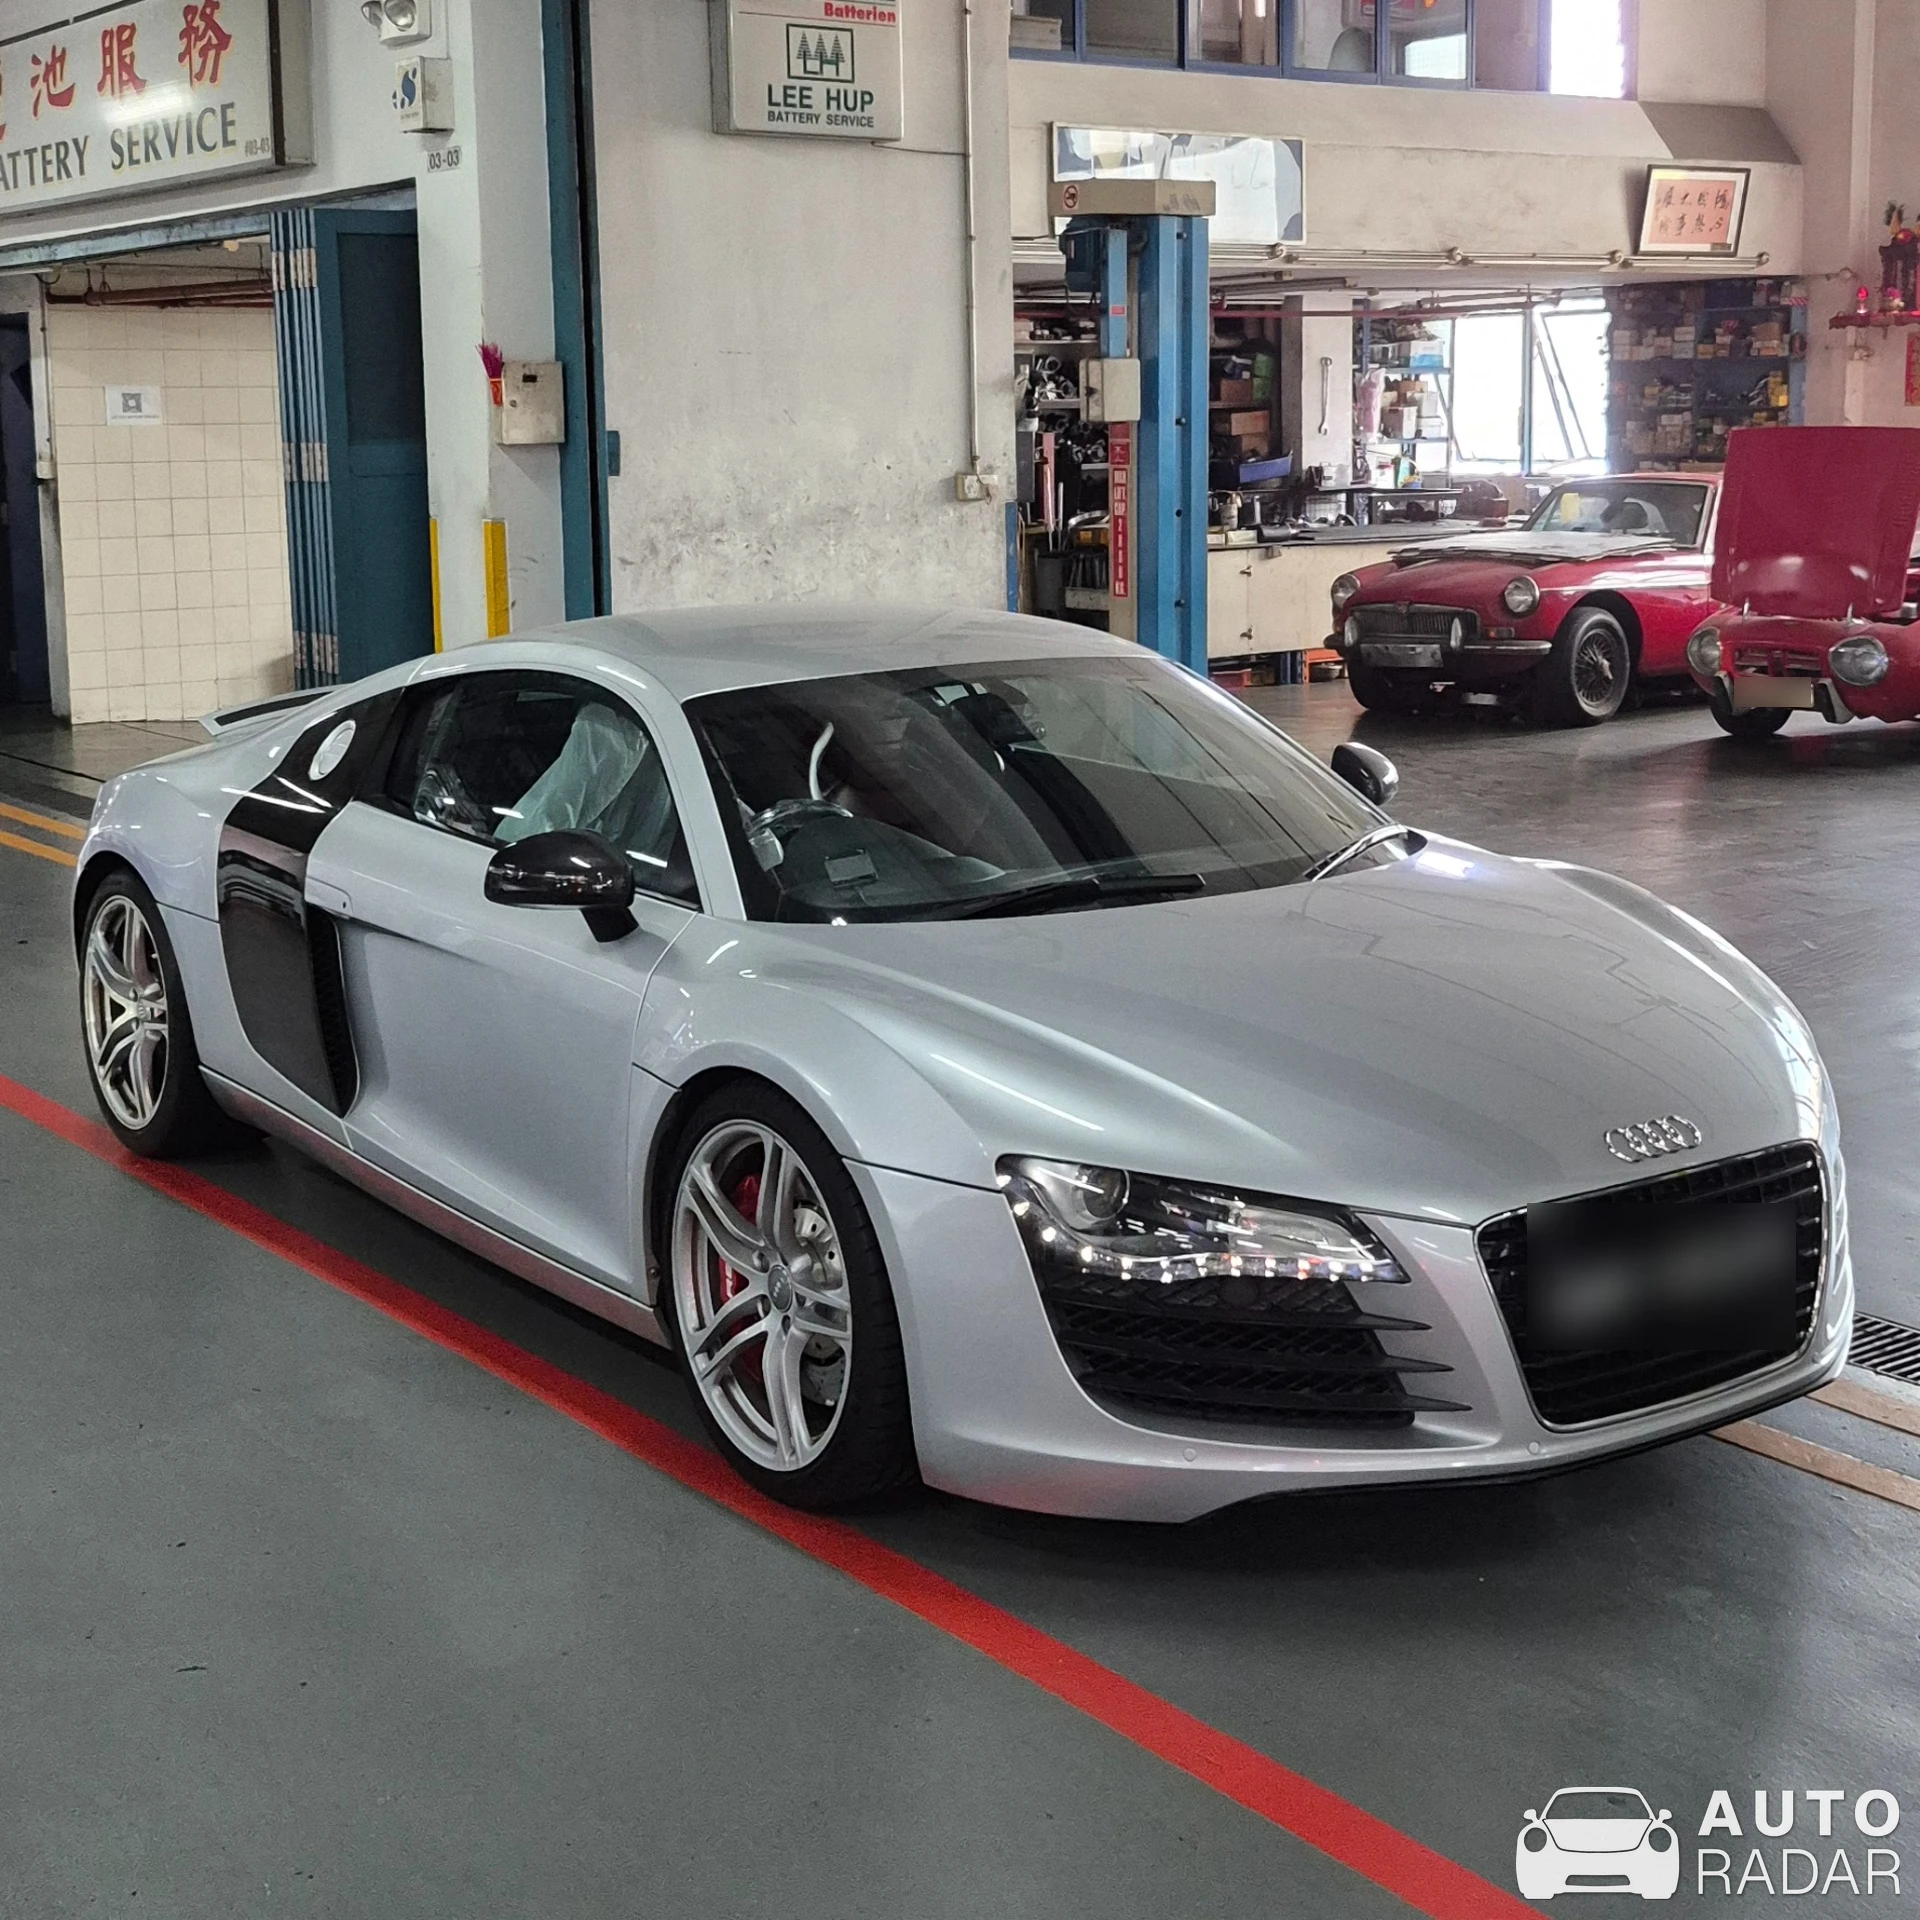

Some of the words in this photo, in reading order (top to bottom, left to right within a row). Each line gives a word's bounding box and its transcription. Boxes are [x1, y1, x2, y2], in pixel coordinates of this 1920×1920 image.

[824, 2, 896, 23] Batterien
[0, 0, 232, 141] 池服務
[768, 84, 813, 109] LEE
[826, 88, 874, 113] HUP
[767, 110, 821, 125] BATTERY
[826, 113, 874, 128] SERVICE
[110, 101, 236, 171] SERVICE
[429, 149, 460, 170] 03-03
